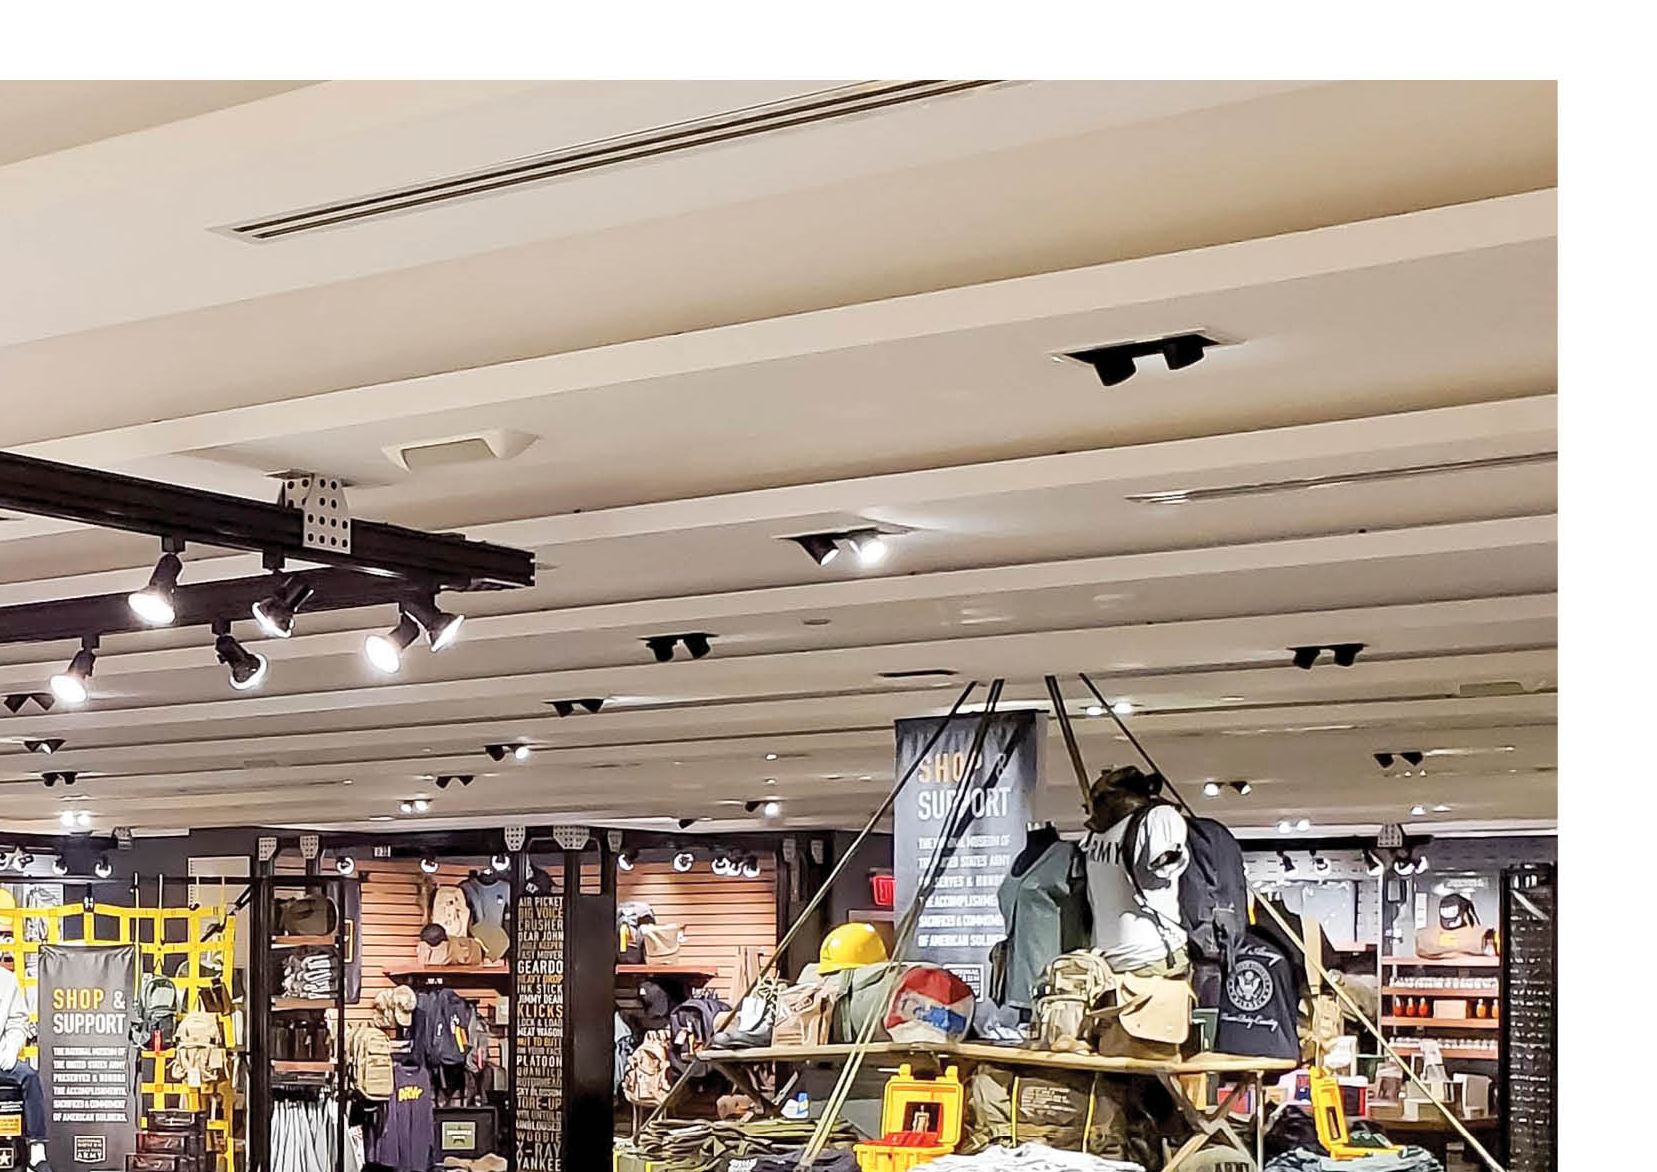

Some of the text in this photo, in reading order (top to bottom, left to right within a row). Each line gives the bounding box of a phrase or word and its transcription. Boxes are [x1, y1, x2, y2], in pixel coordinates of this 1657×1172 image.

[518, 920, 563, 931] CRUSHER
[542, 931, 564, 941] JOHN
[517, 960, 563, 974] GEARDO
[536, 984, 563, 994] STICK
[53, 988, 126, 1010] SHOP &
[517, 1004, 563, 1018] KLICKS
[52, 1013, 126, 1035] SUPPORT
[516, 1055, 562, 1067] PLATOON
[516, 1097, 562, 1110] TORE-UP
[516, 1141, 561, 1159] X-RAY
[516, 1158, 562, 1172] YANKEE
